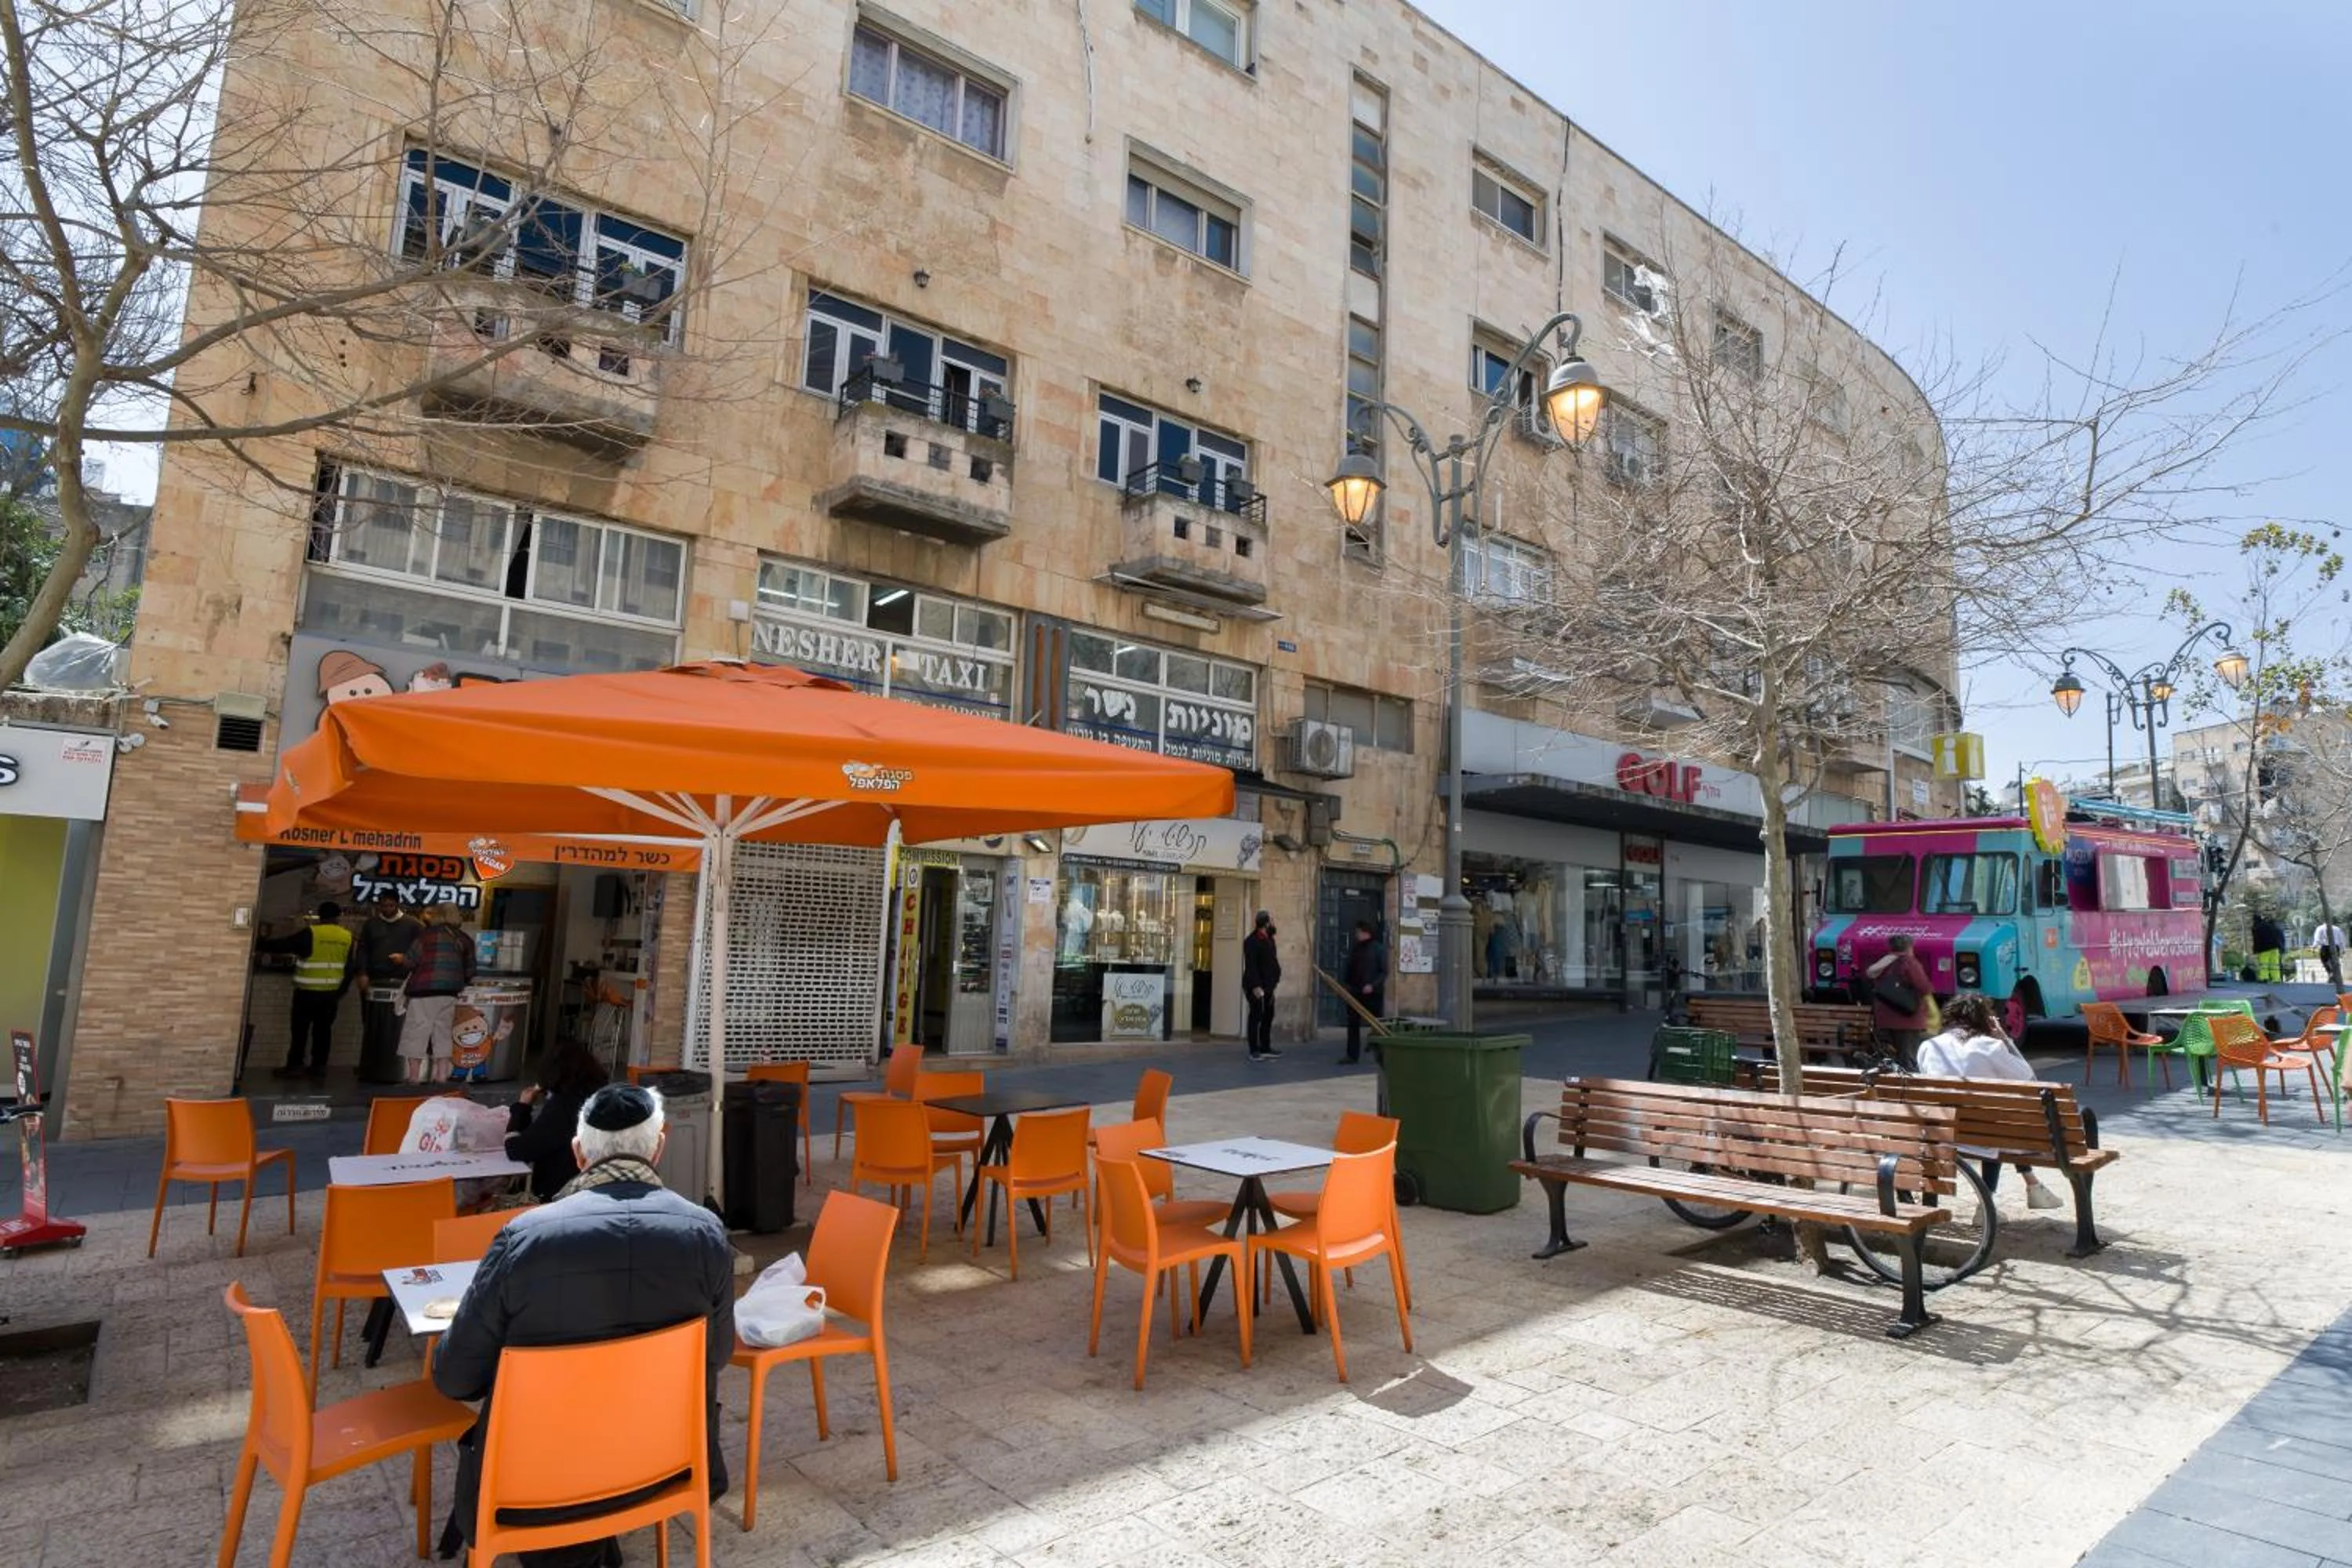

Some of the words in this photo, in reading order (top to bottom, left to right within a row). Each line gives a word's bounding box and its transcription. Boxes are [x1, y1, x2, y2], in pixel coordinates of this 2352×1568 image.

[753, 620, 881, 673] NESHER
[920, 652, 987, 691] TAXI
[1085, 686, 1136, 721] נשר
[1167, 702, 1252, 742] מוניות
[849, 775, 900, 790] הפלאפל
[1617, 752, 1702, 803] GOLF
[377, 853, 464, 880] פסגת
[554, 844, 628, 862] למהדרין
[633, 851, 670, 865] כשר
[898, 849, 957, 866] COMMISSION
